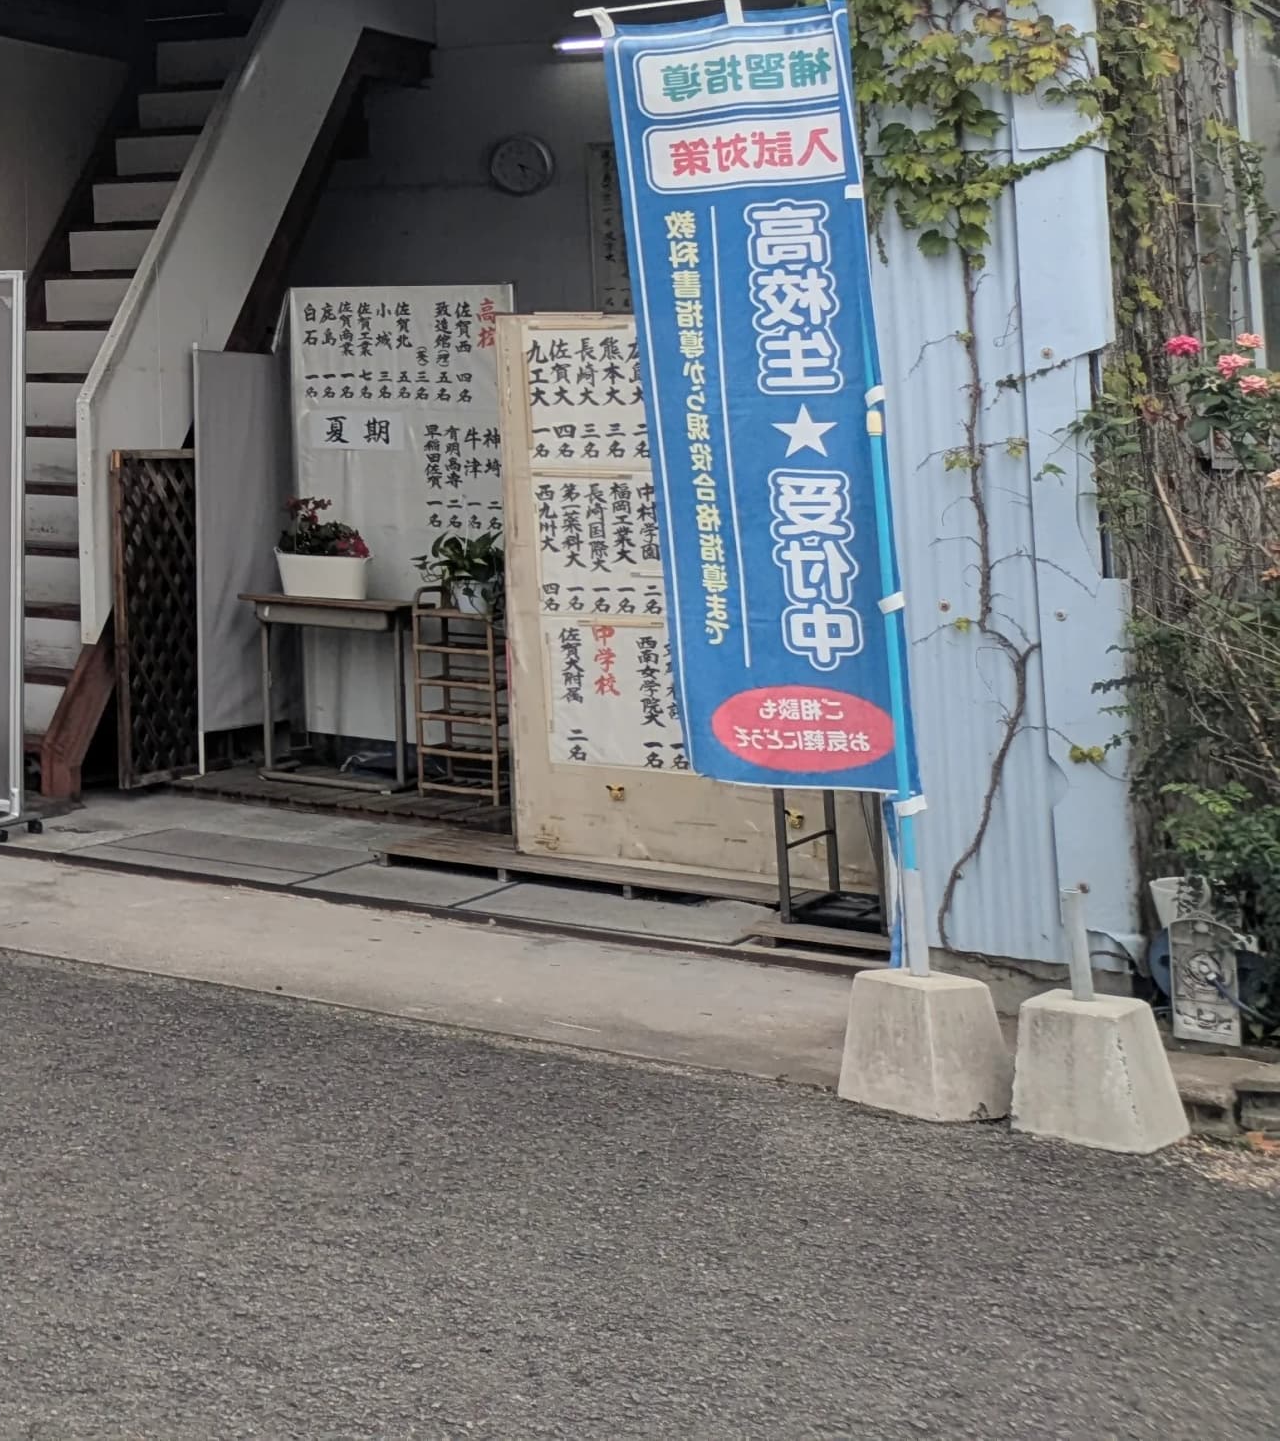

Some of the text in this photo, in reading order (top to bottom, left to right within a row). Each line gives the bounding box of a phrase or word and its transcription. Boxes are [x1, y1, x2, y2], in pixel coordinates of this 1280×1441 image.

[303, 303, 319, 346] 白石
[375, 302, 393, 400] 小城 三名
[394, 301, 413, 400] 佐賀北 五名
[454, 301, 473, 403] 佐賀西 四名
[358, 369, 373, 400] 七名
[415, 371, 430, 401] 三名
[435, 371, 453, 402] 五名
[598, 336, 627, 406] 熊本大
[527, 339, 550, 458] 九工大 一名
[549, 338, 576, 458] 佐賀大 四名
[574, 337, 601, 459] 長崎大 三名
[324, 415, 390, 445] 夏期
[605, 422, 626, 459] 三名
[463, 426, 482, 479] 牛津
[446, 499, 463, 529] 二名
[487, 500, 503, 530] 二名
[609, 482, 637, 614] 福岡工業大 一名
[542, 582, 560, 611] 四名
[566, 586, 585, 611] 一名
[592, 587, 611, 613] 一名
[643, 585, 662, 615] 二名
[592, 624, 621, 697] 中学校
[567, 729, 588, 761] 二名
[643, 742, 664, 769] 一名
